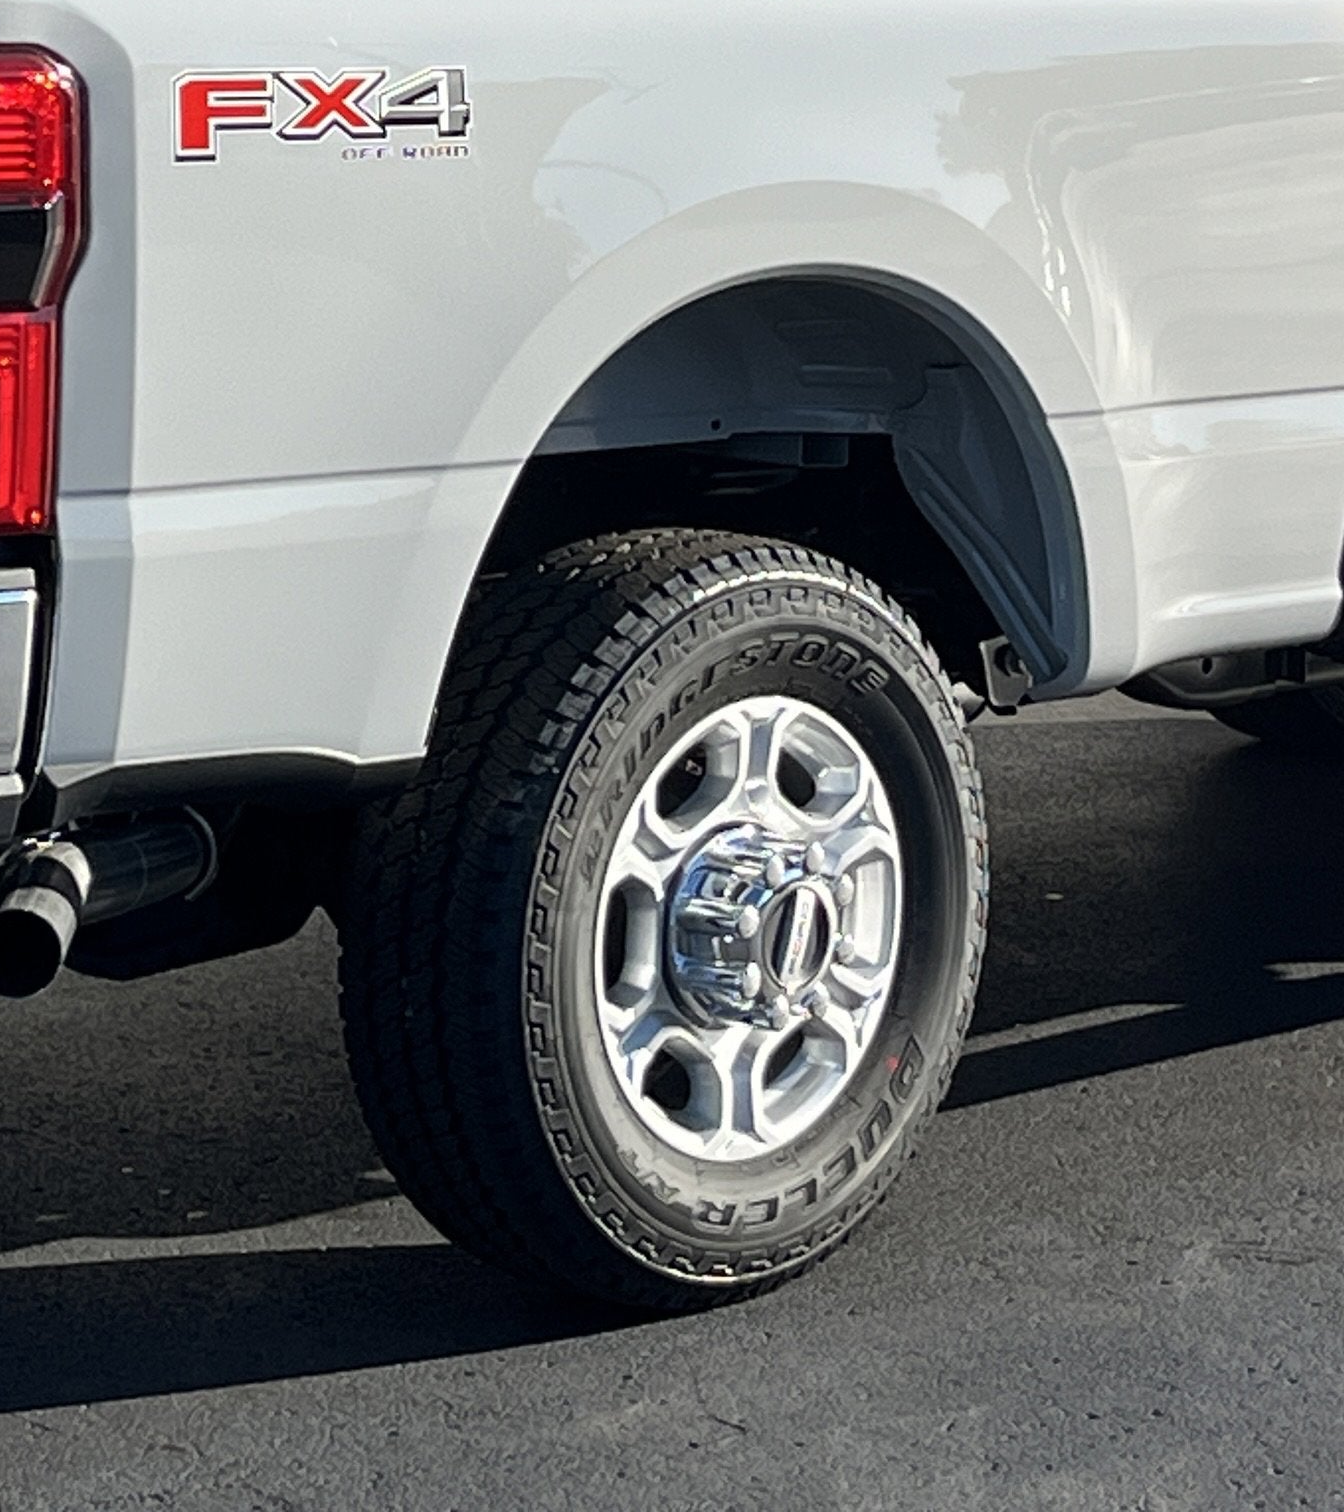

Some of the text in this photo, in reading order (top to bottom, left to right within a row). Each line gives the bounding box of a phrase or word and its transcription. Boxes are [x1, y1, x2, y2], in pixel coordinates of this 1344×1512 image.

[171, 66, 472, 165] FX4
[341, 144, 470, 161] OFF ROAD
